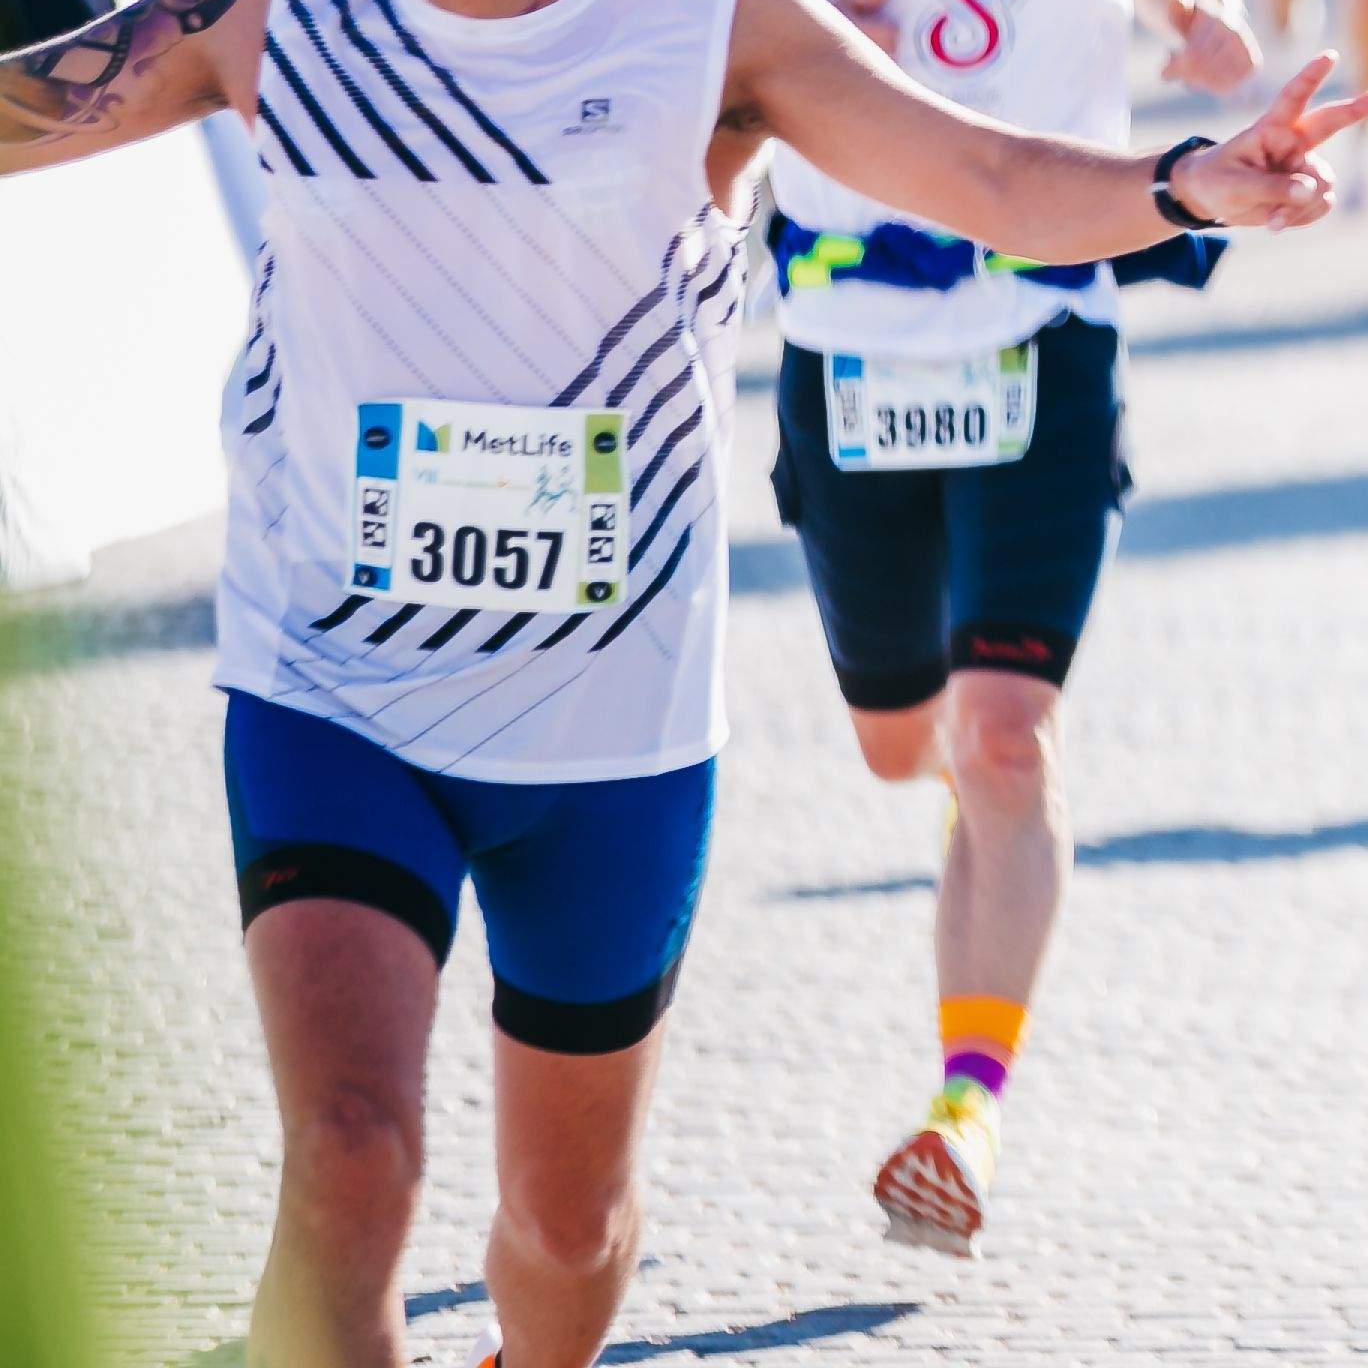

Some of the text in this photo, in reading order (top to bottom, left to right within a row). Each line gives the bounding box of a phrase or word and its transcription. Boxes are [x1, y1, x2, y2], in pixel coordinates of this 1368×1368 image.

[463, 428, 573, 457] MetLife
[876, 405, 985, 447] 3980
[411, 521, 564, 591] 3057
